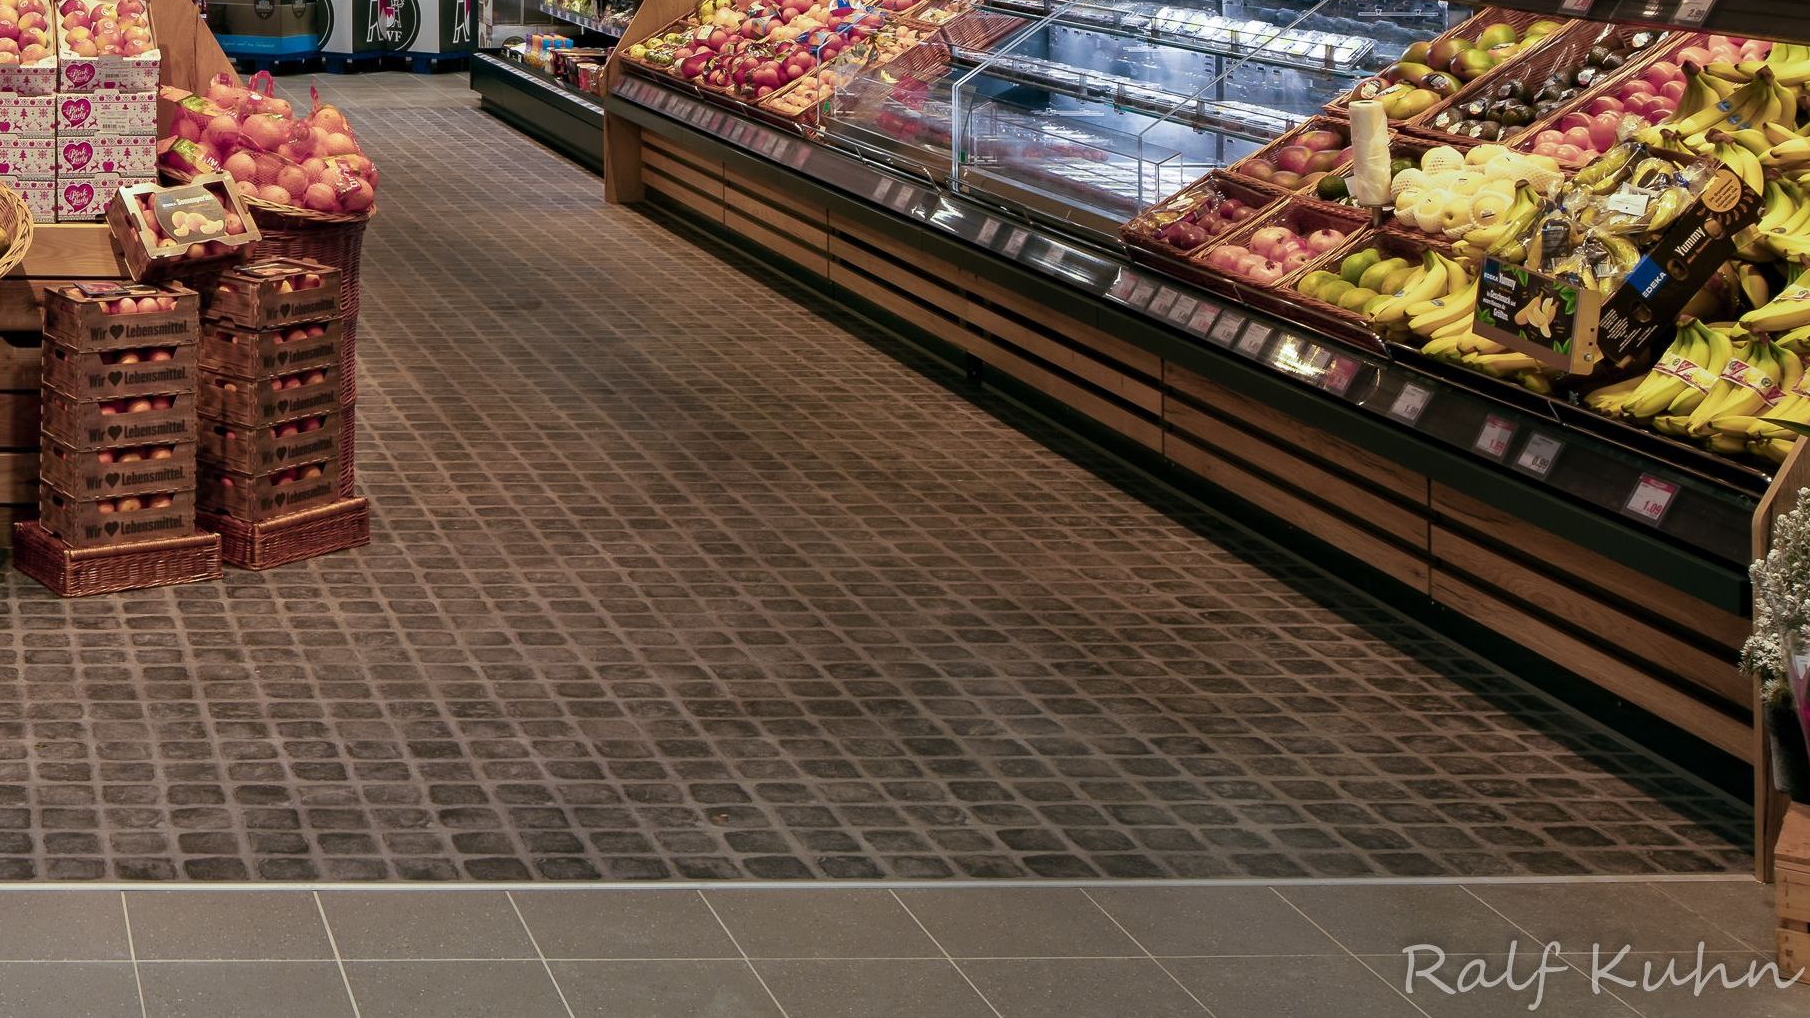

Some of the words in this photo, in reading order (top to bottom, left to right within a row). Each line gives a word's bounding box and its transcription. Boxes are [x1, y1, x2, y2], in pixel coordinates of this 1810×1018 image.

[1674, 226, 1706, 257] Yummy
[1642, 272, 1667, 299] EDEKA
[90, 326, 108, 341] Wir
[125, 320, 190, 338] Lebensmittel.
[89, 374, 106, 388] Wir
[124, 366, 188, 384] Lebensmittel.
[88, 428, 105, 442] Wir
[124, 419, 188, 438] Lebensmittel.
[86, 476, 103, 490] Wir
[121, 466, 186, 486] Lebensmittel.
[1642, 499, 1663, 516] 1.09
[85, 525, 102, 539] Wir
[120, 514, 184, 534] Lebensmittel.
